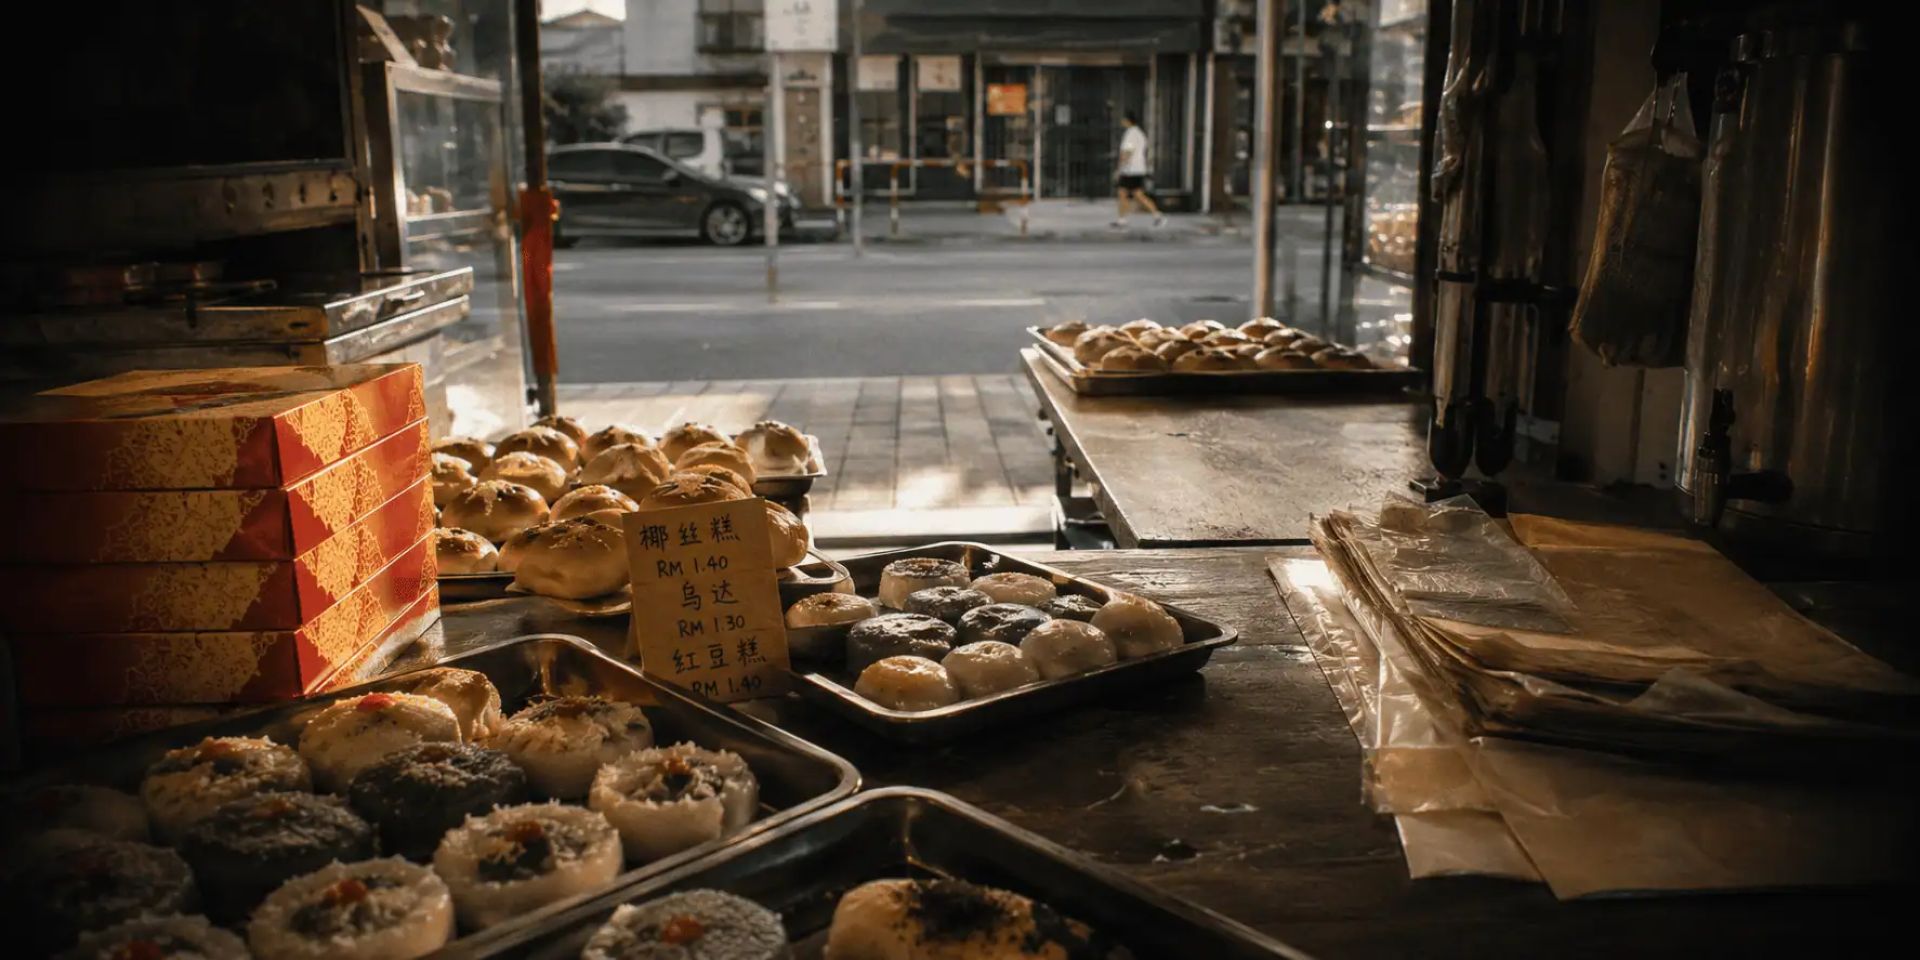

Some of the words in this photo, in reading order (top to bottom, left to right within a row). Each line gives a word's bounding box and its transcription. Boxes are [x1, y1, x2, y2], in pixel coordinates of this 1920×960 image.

[639, 514, 741, 551] 椰丝糕
[657, 559, 684, 578] RM
[693, 555, 729, 574] 1.40
[681, 580, 739, 611] 乌达
[678, 619, 704, 638] RM
[714, 615, 746, 634] 1.30
[671, 636, 767, 674] 红豆糕
[691, 680, 719, 698] RM
[727, 675, 763, 694] 1.40
